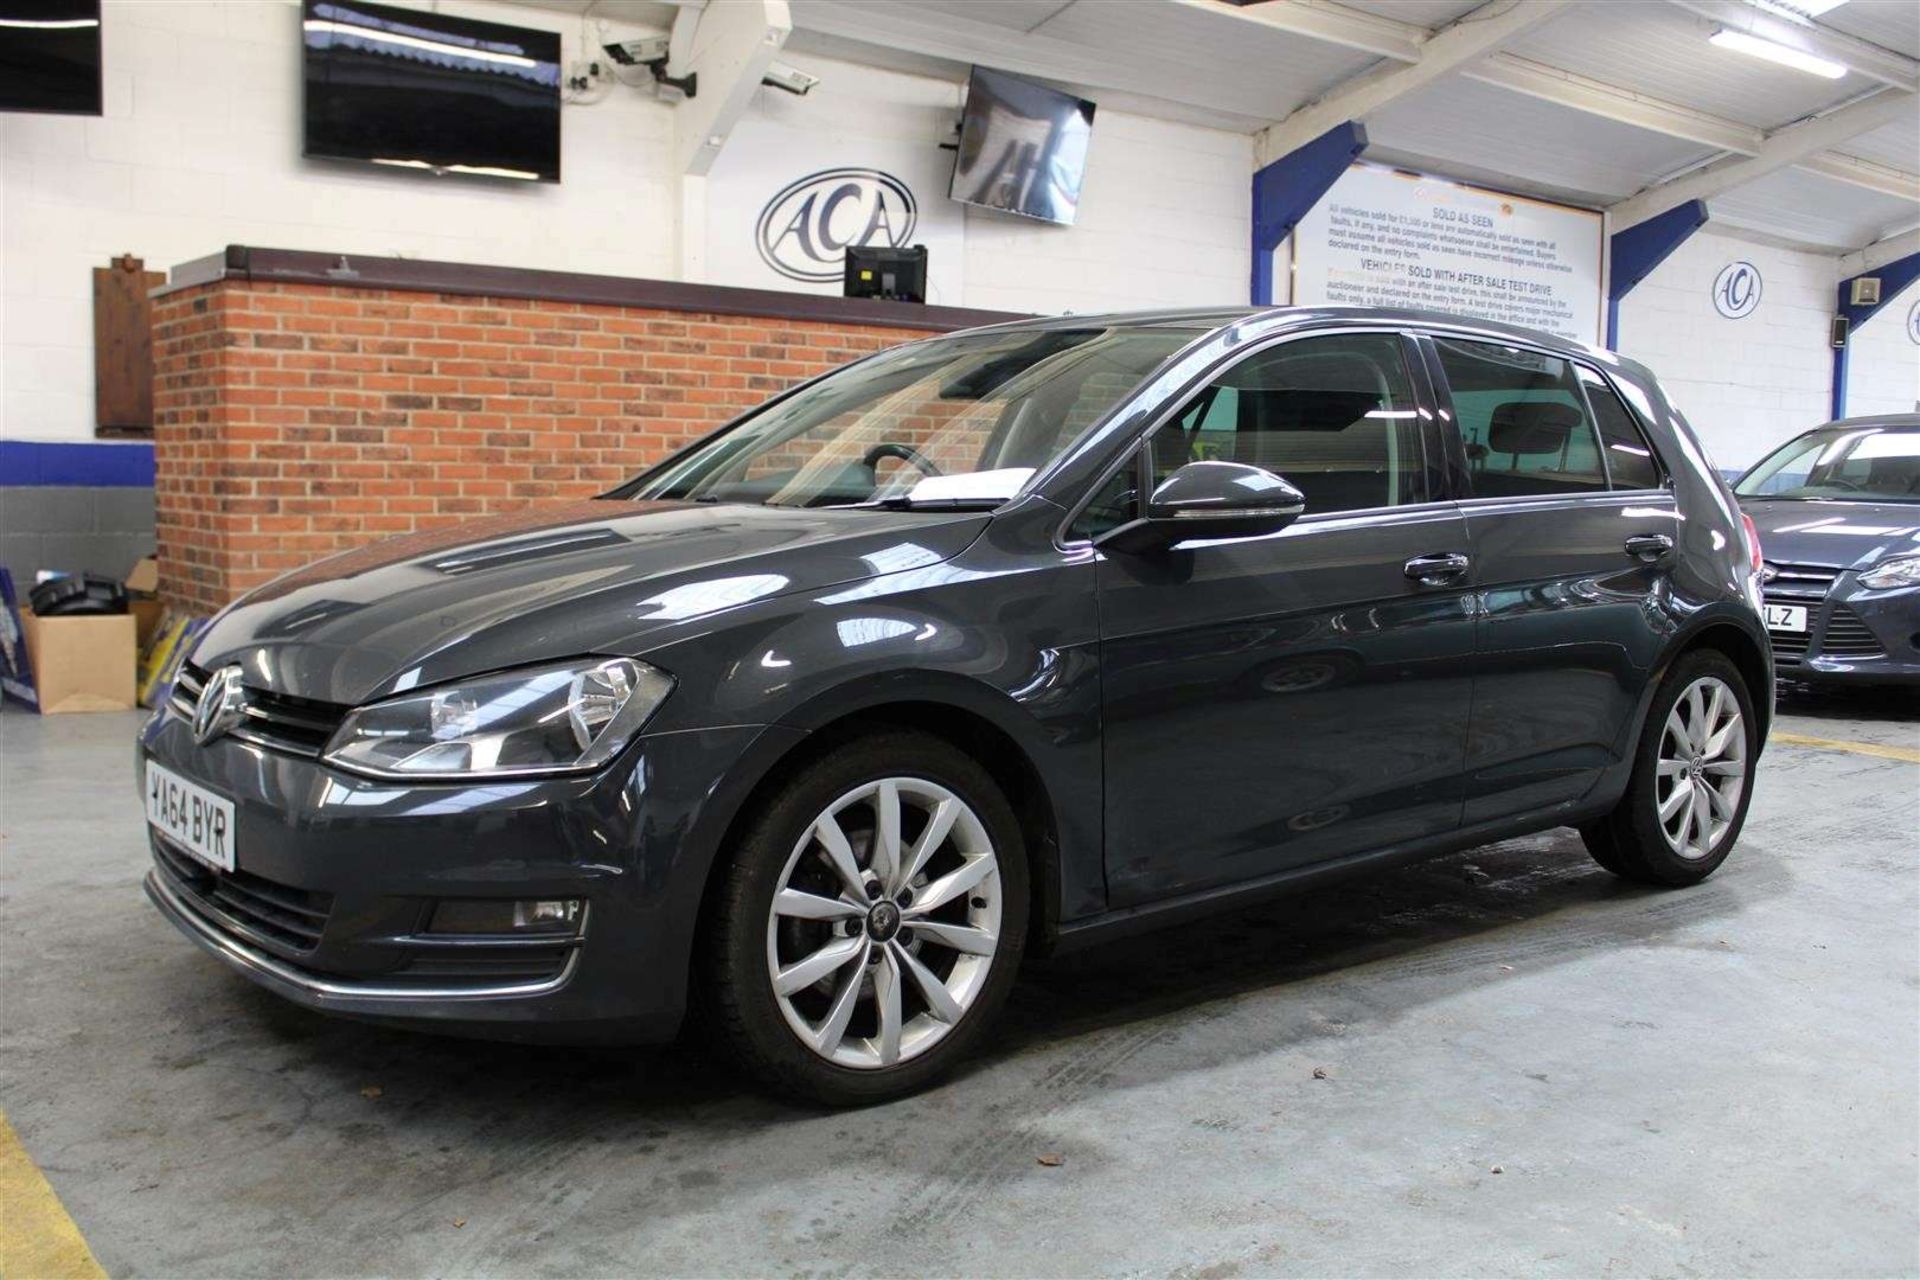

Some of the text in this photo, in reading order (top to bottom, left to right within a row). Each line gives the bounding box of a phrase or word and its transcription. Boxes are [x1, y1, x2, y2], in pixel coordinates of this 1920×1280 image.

[771, 183, 895, 263] ACA
[1341, 205, 1368, 217] vehicles
[1371, 210, 1385, 220] sold
[1457, 226, 1496, 240] automatically
[1499, 233, 1510, 241] sold
[1536, 239, 1547, 248] with
[1377, 223, 1389, 232] and
[1402, 227, 1437, 241] complaints
[1433, 207, 1493, 228] SOLD AS SEEN
[1328, 238, 1358, 251] declared
[1371, 244, 1382, 253] the
[1384, 247, 1401, 259] entry
[1348, 230, 1374, 241] assume
[1387, 236, 1415, 248] vehicles
[1416, 241, 1430, 250] sold
[1441, 246, 1455, 254] seen
[1473, 250, 1500, 261] incorrect
[1502, 255, 1524, 267] mileage
[1326, 290, 1346, 301] faults
[1327, 279, 1363, 292] auctioneer
[1365, 285, 1378, 294] and
[1381, 286, 1410, 298] declared
[1421, 292, 1430, 300] the
[1433, 294, 1448, 305] entry
[1487, 301, 1502, 310] drive
[1408, 264, 1432, 279] SOLD
[1434, 268, 1455, 282] WITH
[1458, 272, 1484, 287] AFTER
[1486, 276, 1507, 290] SALE
[1508, 279, 1528, 293] TEST
[1529, 282, 1552, 296] DRIVE
[1417, 280, 1431, 289] after
[1716, 268, 1755, 310] ACA
[1763, 607, 1793, 626] LZ
[152, 770, 226, 859] YA64 BYR
